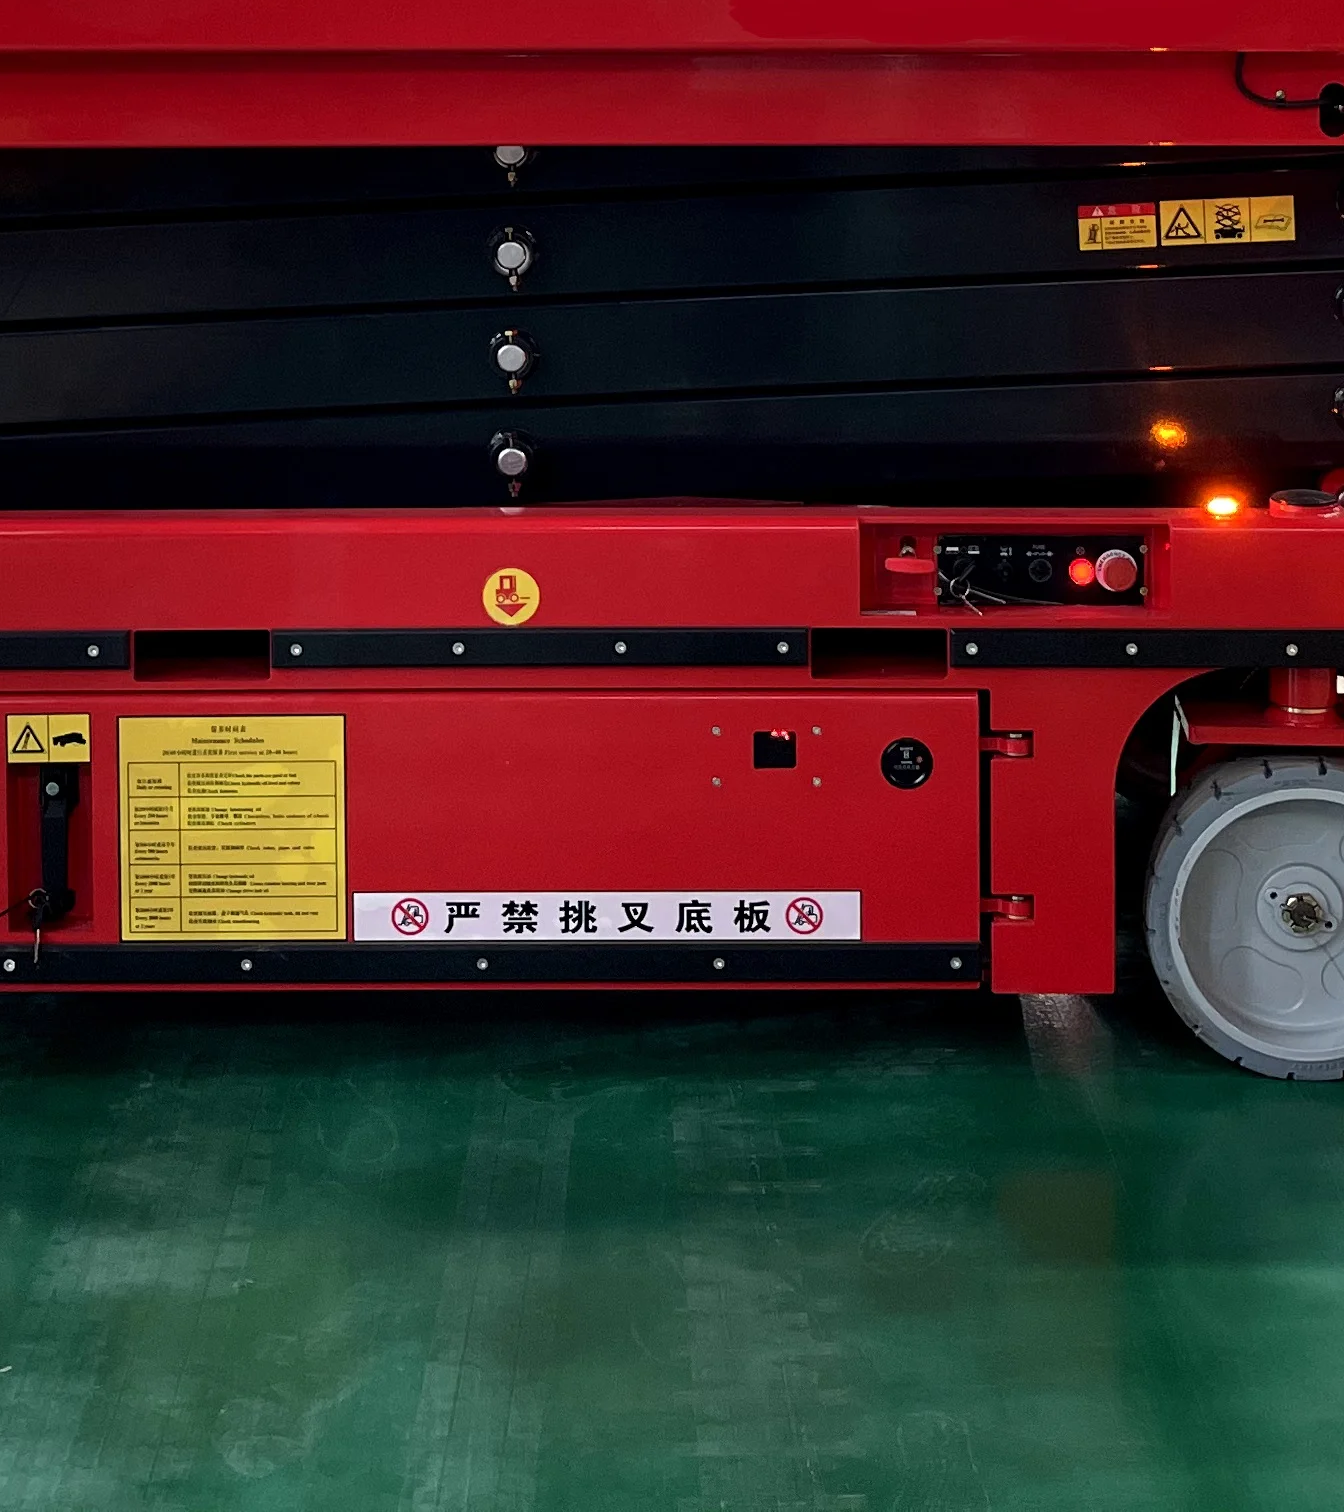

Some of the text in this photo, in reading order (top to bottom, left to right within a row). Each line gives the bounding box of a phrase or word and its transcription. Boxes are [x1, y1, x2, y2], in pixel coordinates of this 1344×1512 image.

[443, 899, 772, 935] 严禁挑叉底板
